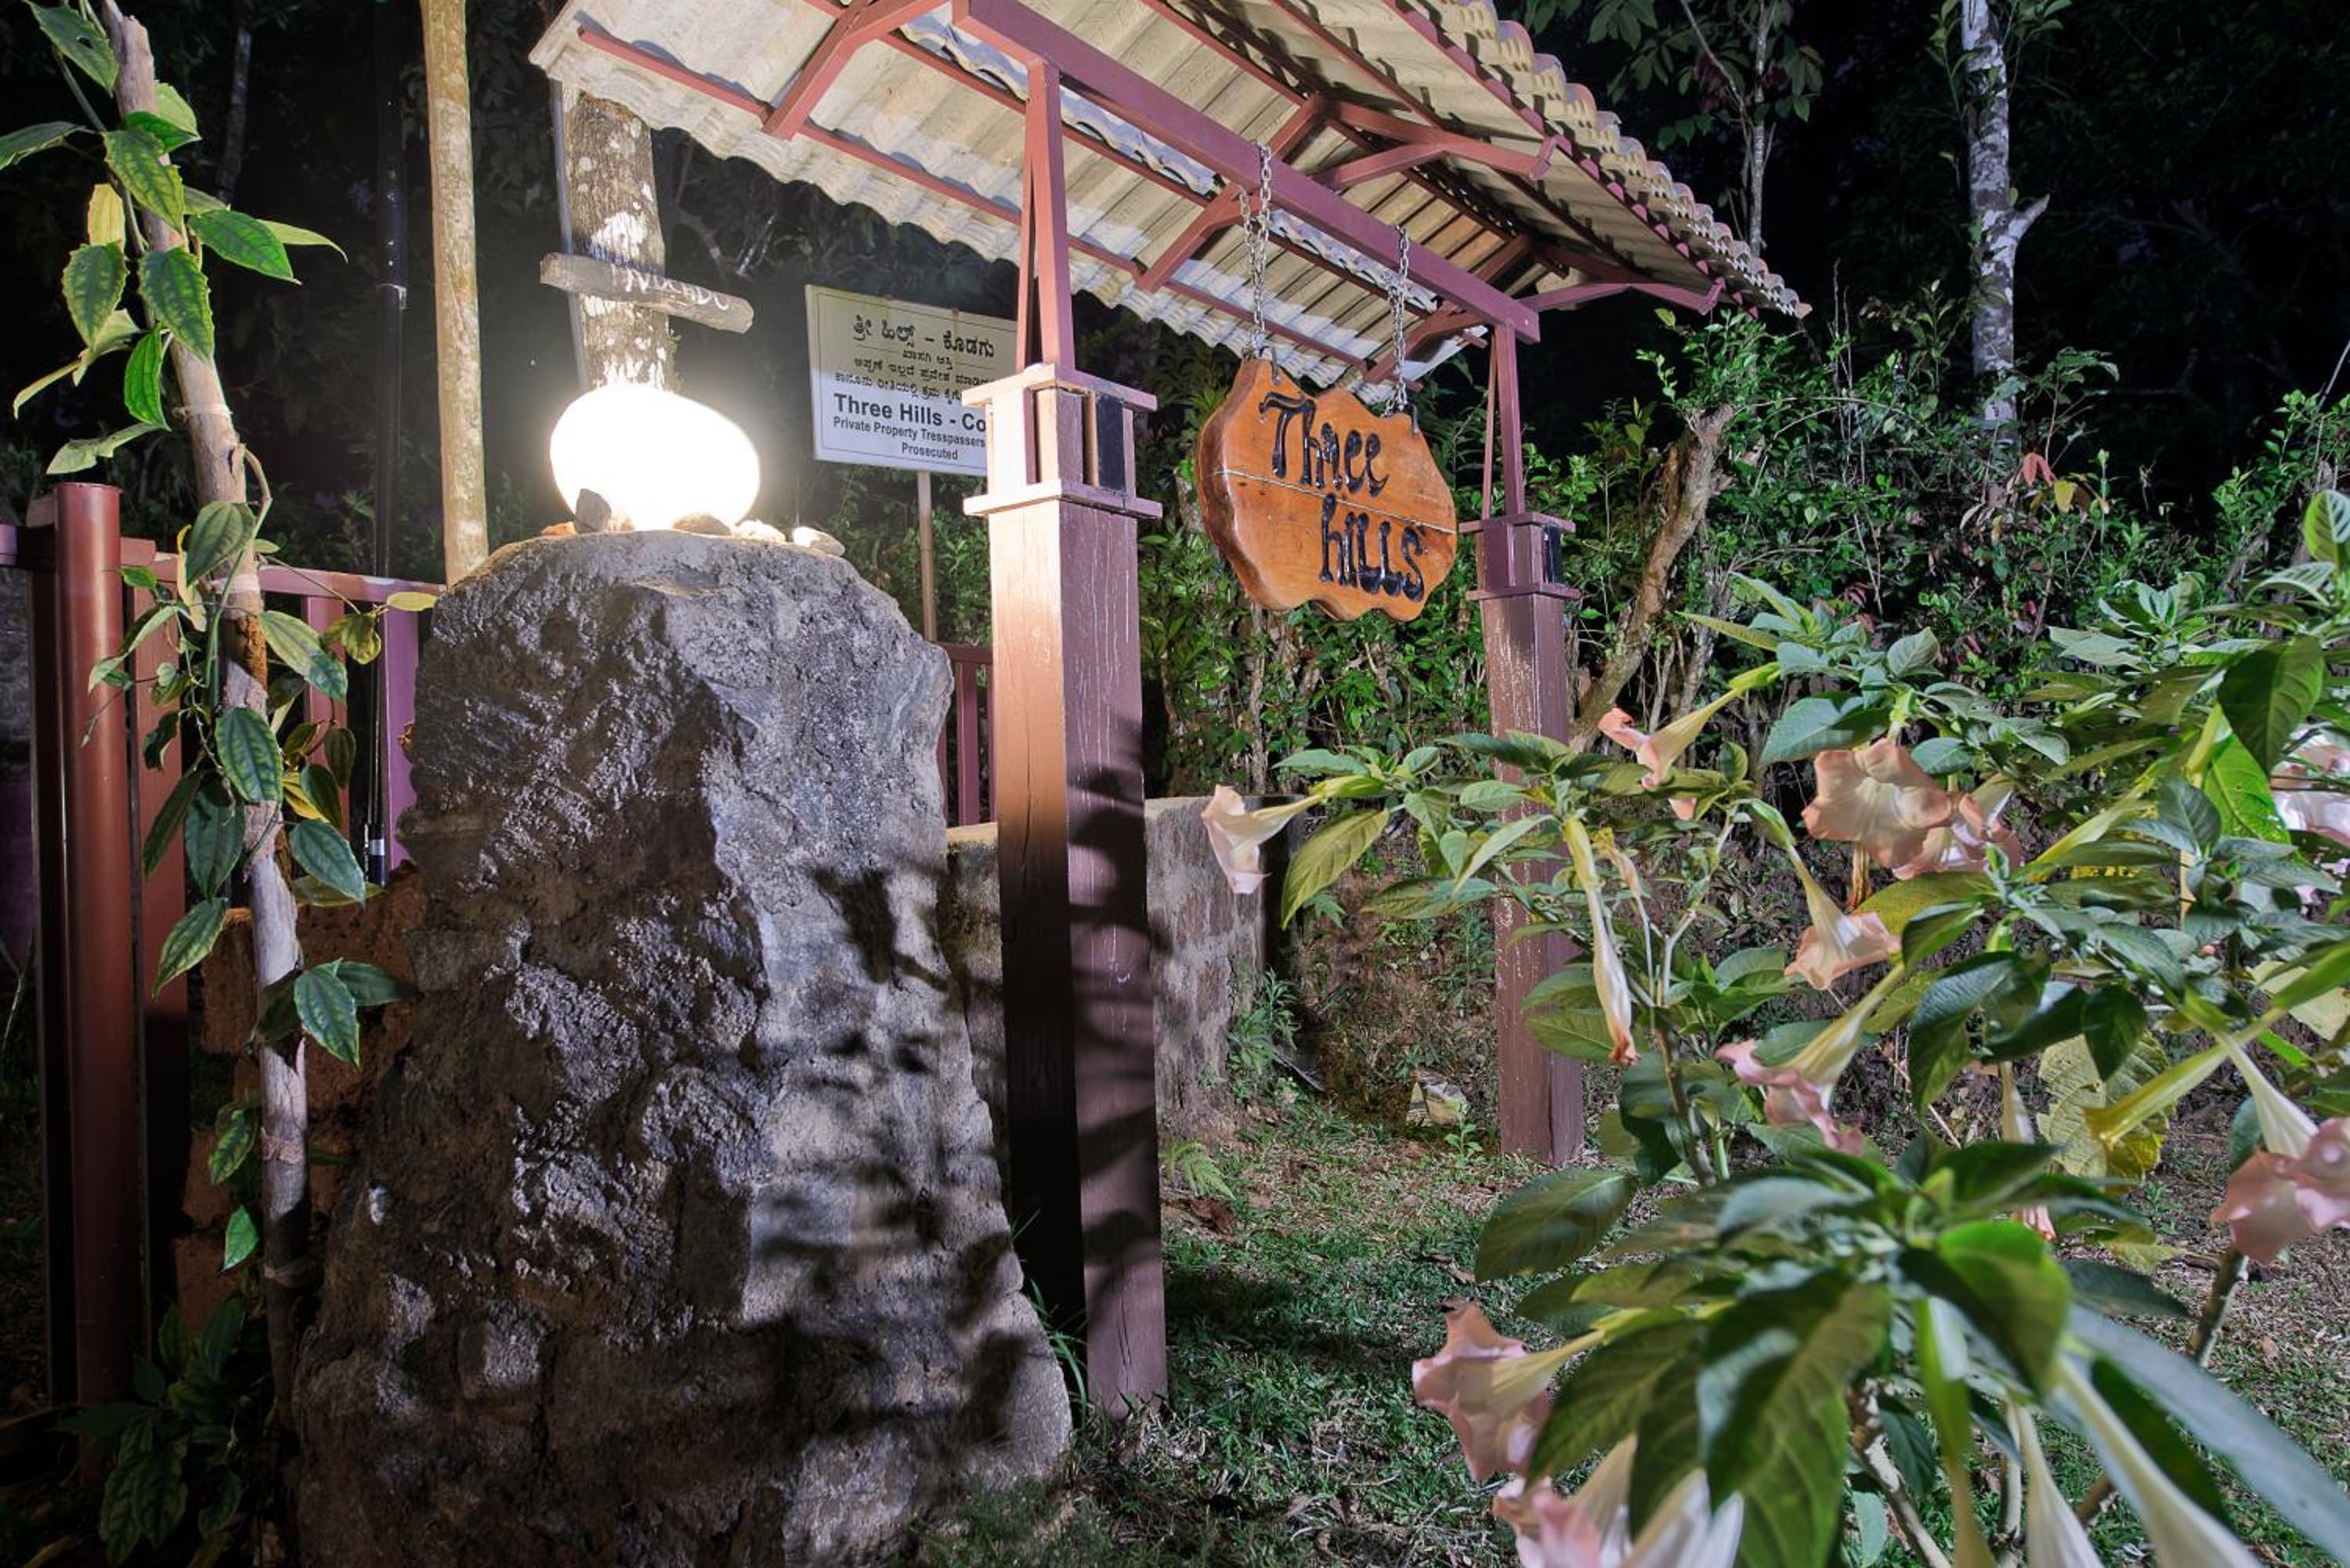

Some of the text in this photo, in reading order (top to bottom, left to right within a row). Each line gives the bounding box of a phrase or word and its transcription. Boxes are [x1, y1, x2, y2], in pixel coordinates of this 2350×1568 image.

[942, 330, 995, 358] ಕೊಡಗು
[834, 393, 892, 418] Three
[900, 403, 943, 427] Hills
[962, 413, 986, 432] Co
[833, 417, 985, 448] Private Property Tresspassers
[902, 443, 958, 460] Prosecuted
